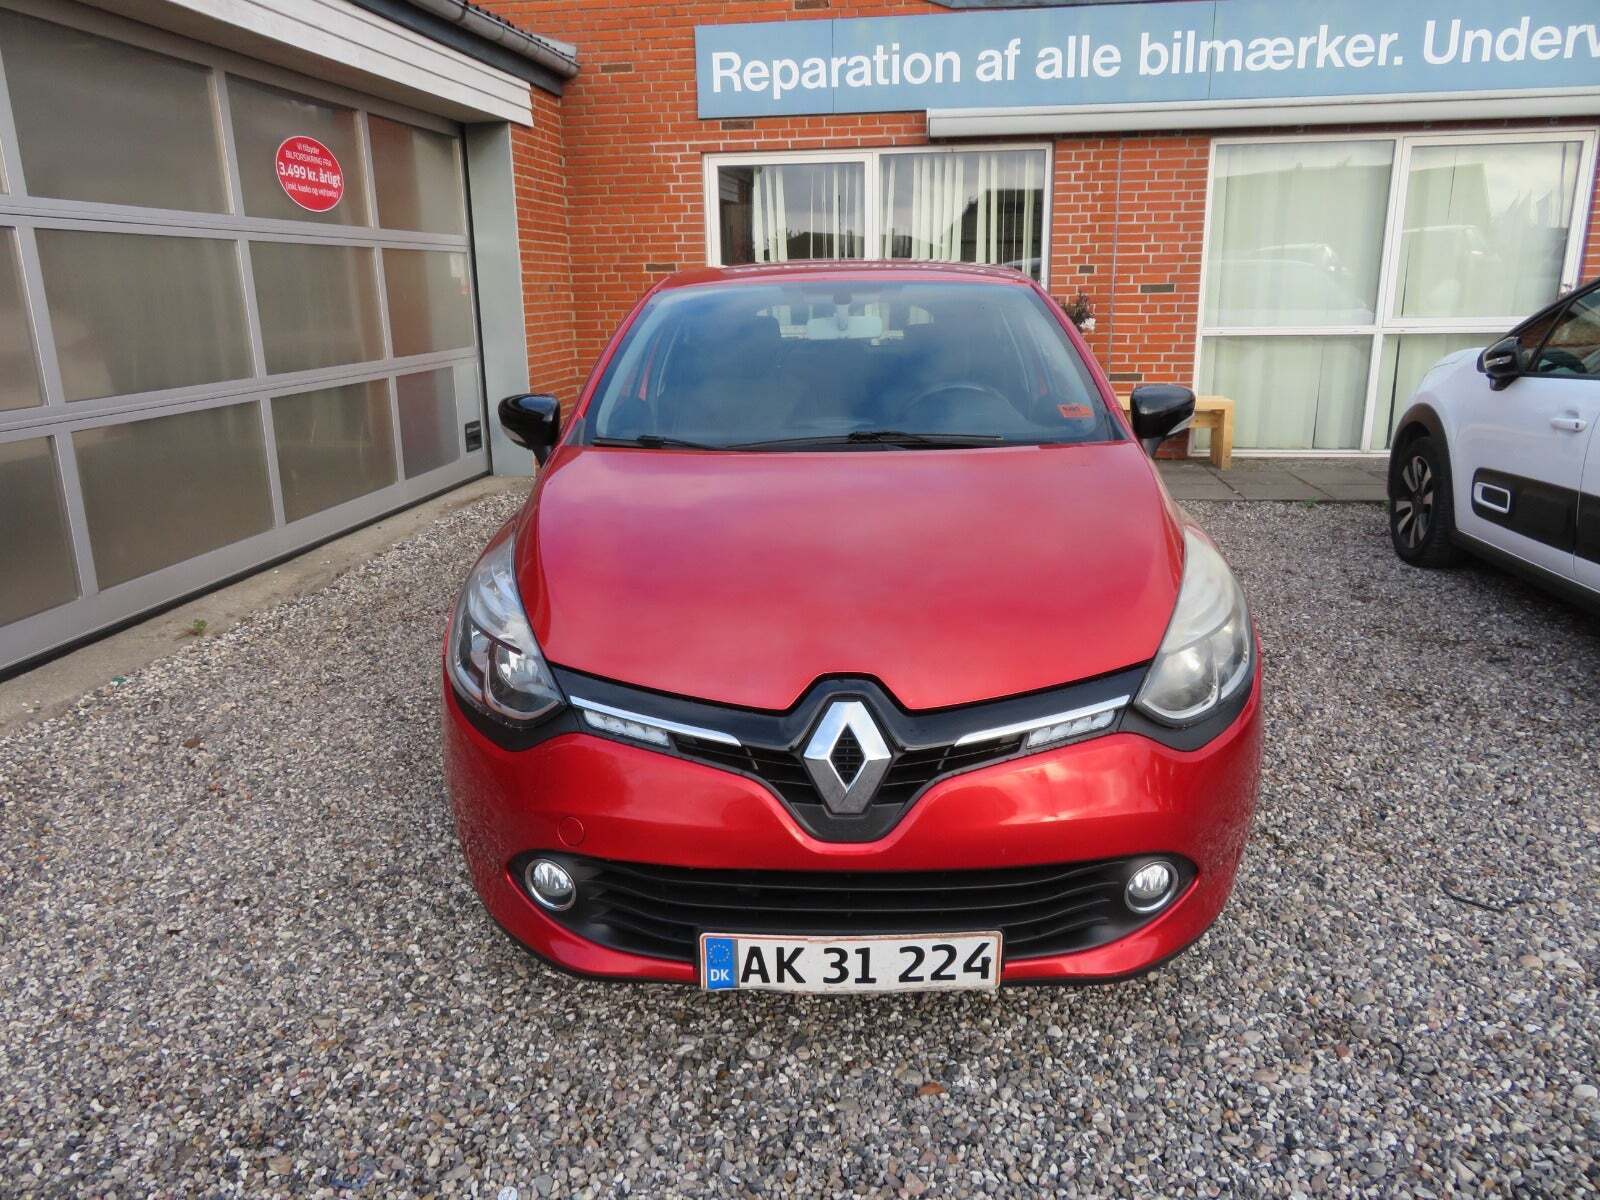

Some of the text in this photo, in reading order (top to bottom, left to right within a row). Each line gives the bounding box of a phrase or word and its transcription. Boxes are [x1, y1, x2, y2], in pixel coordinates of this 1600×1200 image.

[712, 43, 960, 100] Reparation
[976, 38, 1021, 81] af
[1035, 35, 1122, 79] alle
[1139, 25, 1403, 76] bilmærker.
[278, 161, 307, 180] 3.499
[307, 167, 319, 182] kr.
[710, 969, 730, 982] DK
[740, 942, 991, 984] AK 31 224
